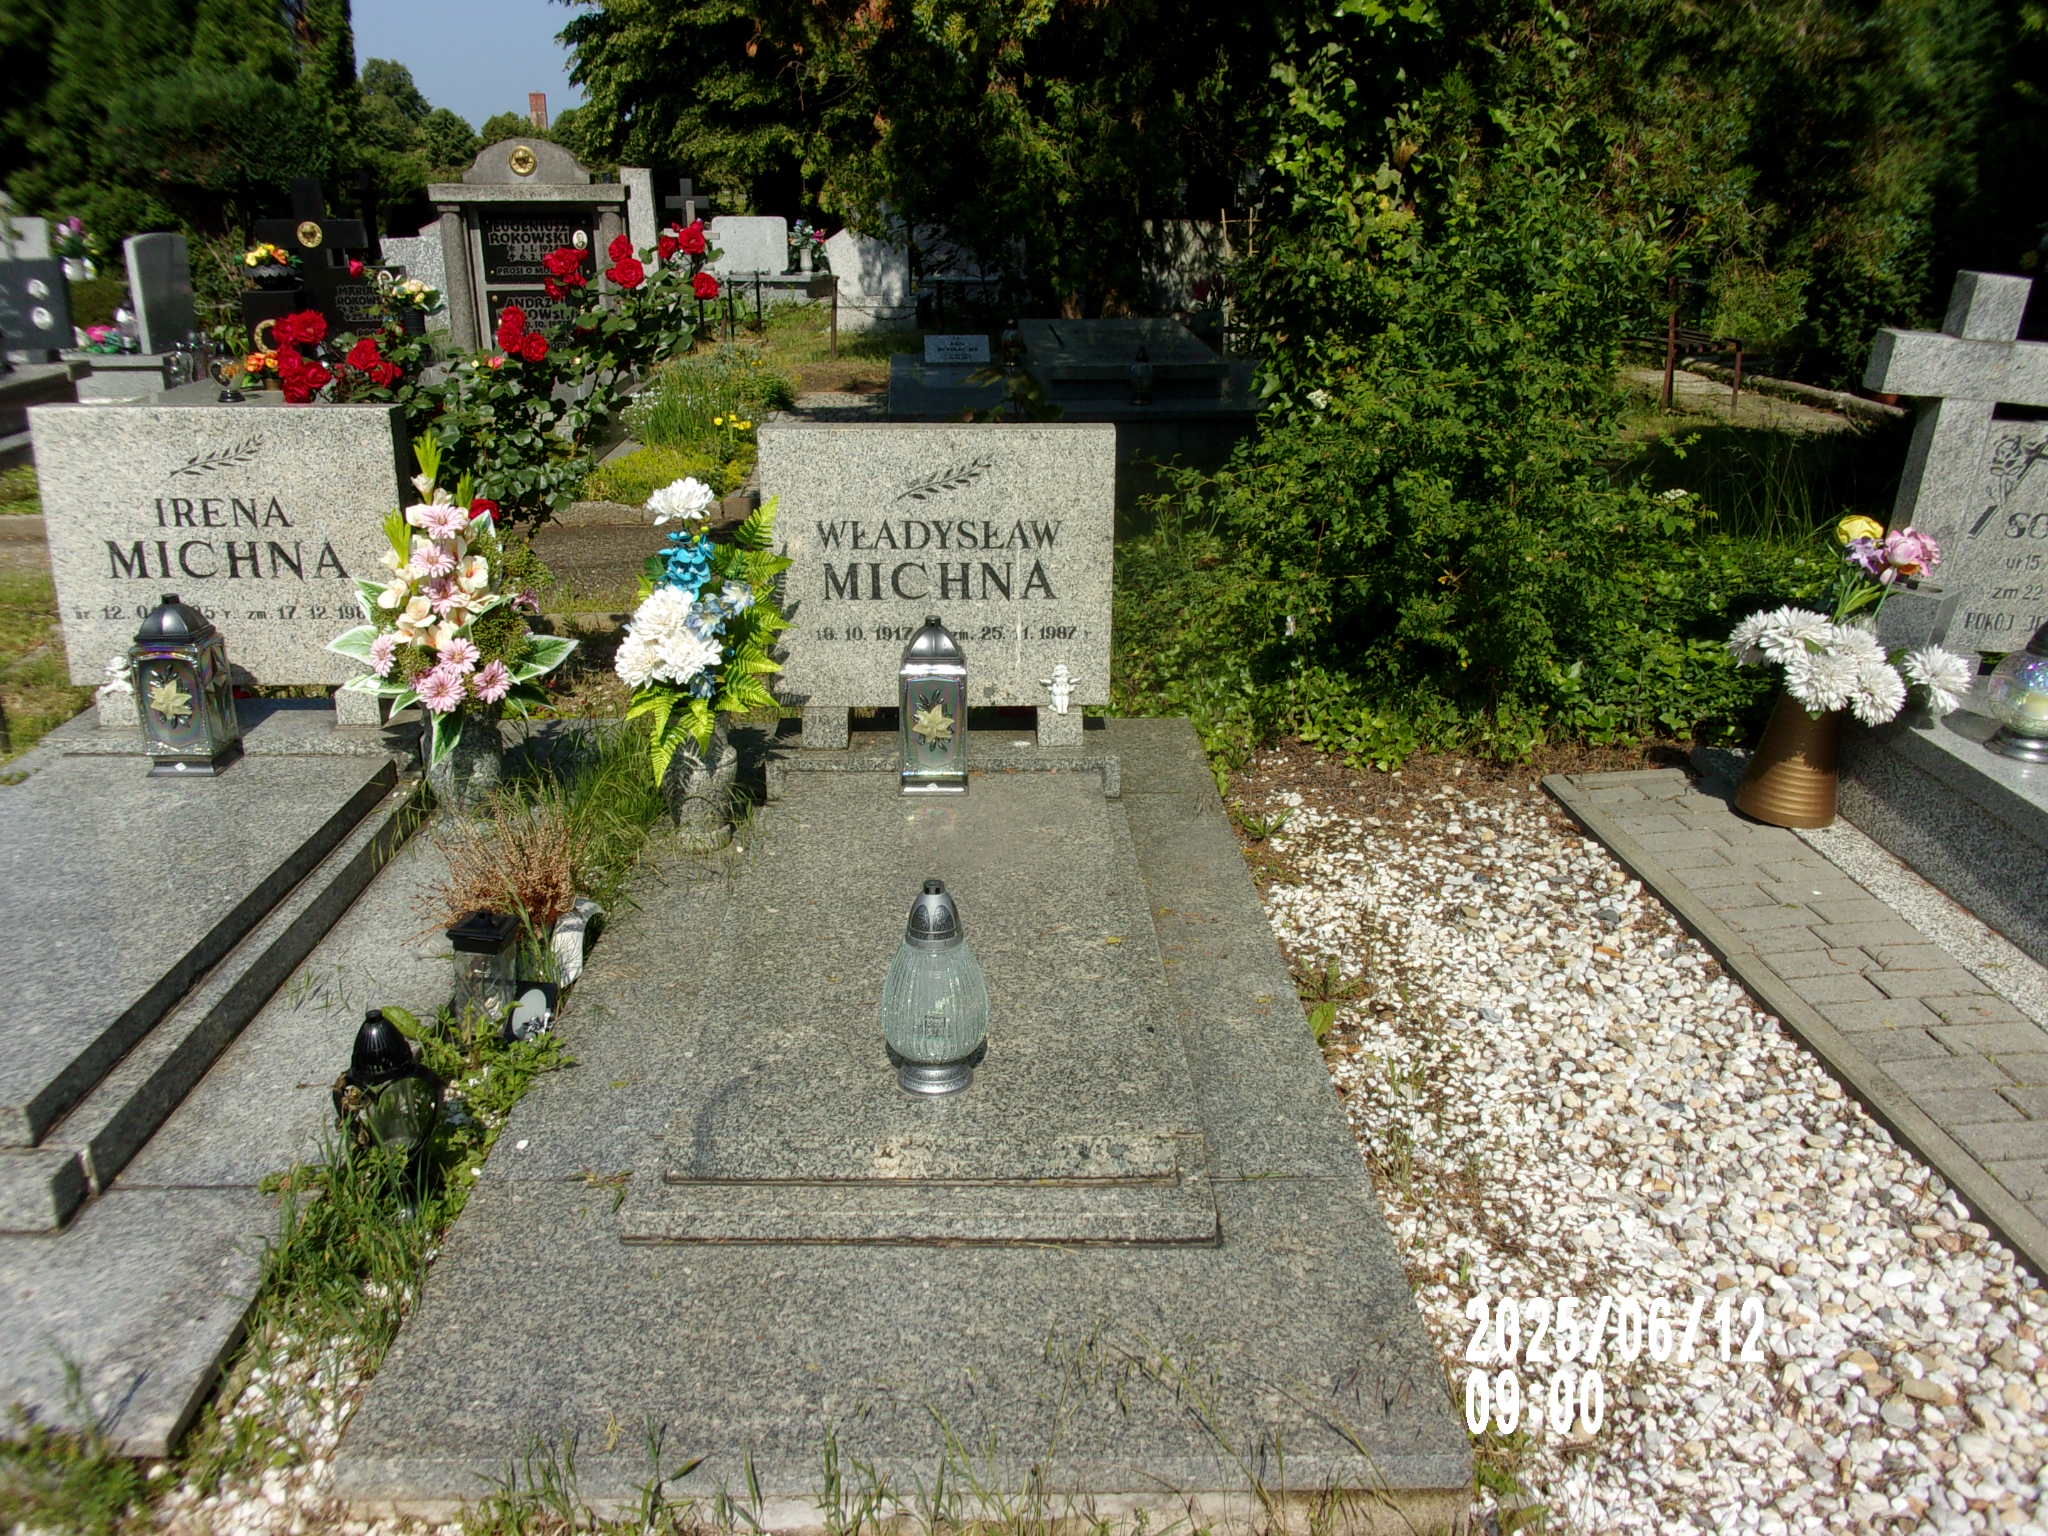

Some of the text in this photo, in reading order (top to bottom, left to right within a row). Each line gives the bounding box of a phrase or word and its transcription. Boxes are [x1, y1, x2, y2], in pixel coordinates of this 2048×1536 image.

[489, 232, 569, 244] ROKOWSKI
[154, 496, 293, 528] IRENA
[816, 518, 1064, 550] WŁADYSŁAW
[105, 539, 351, 580] MICHNA
[823, 558, 1059, 601] MICHNA
[875, 626, 913, 640] 1917
[1040, 626, 1076, 640] 1987
